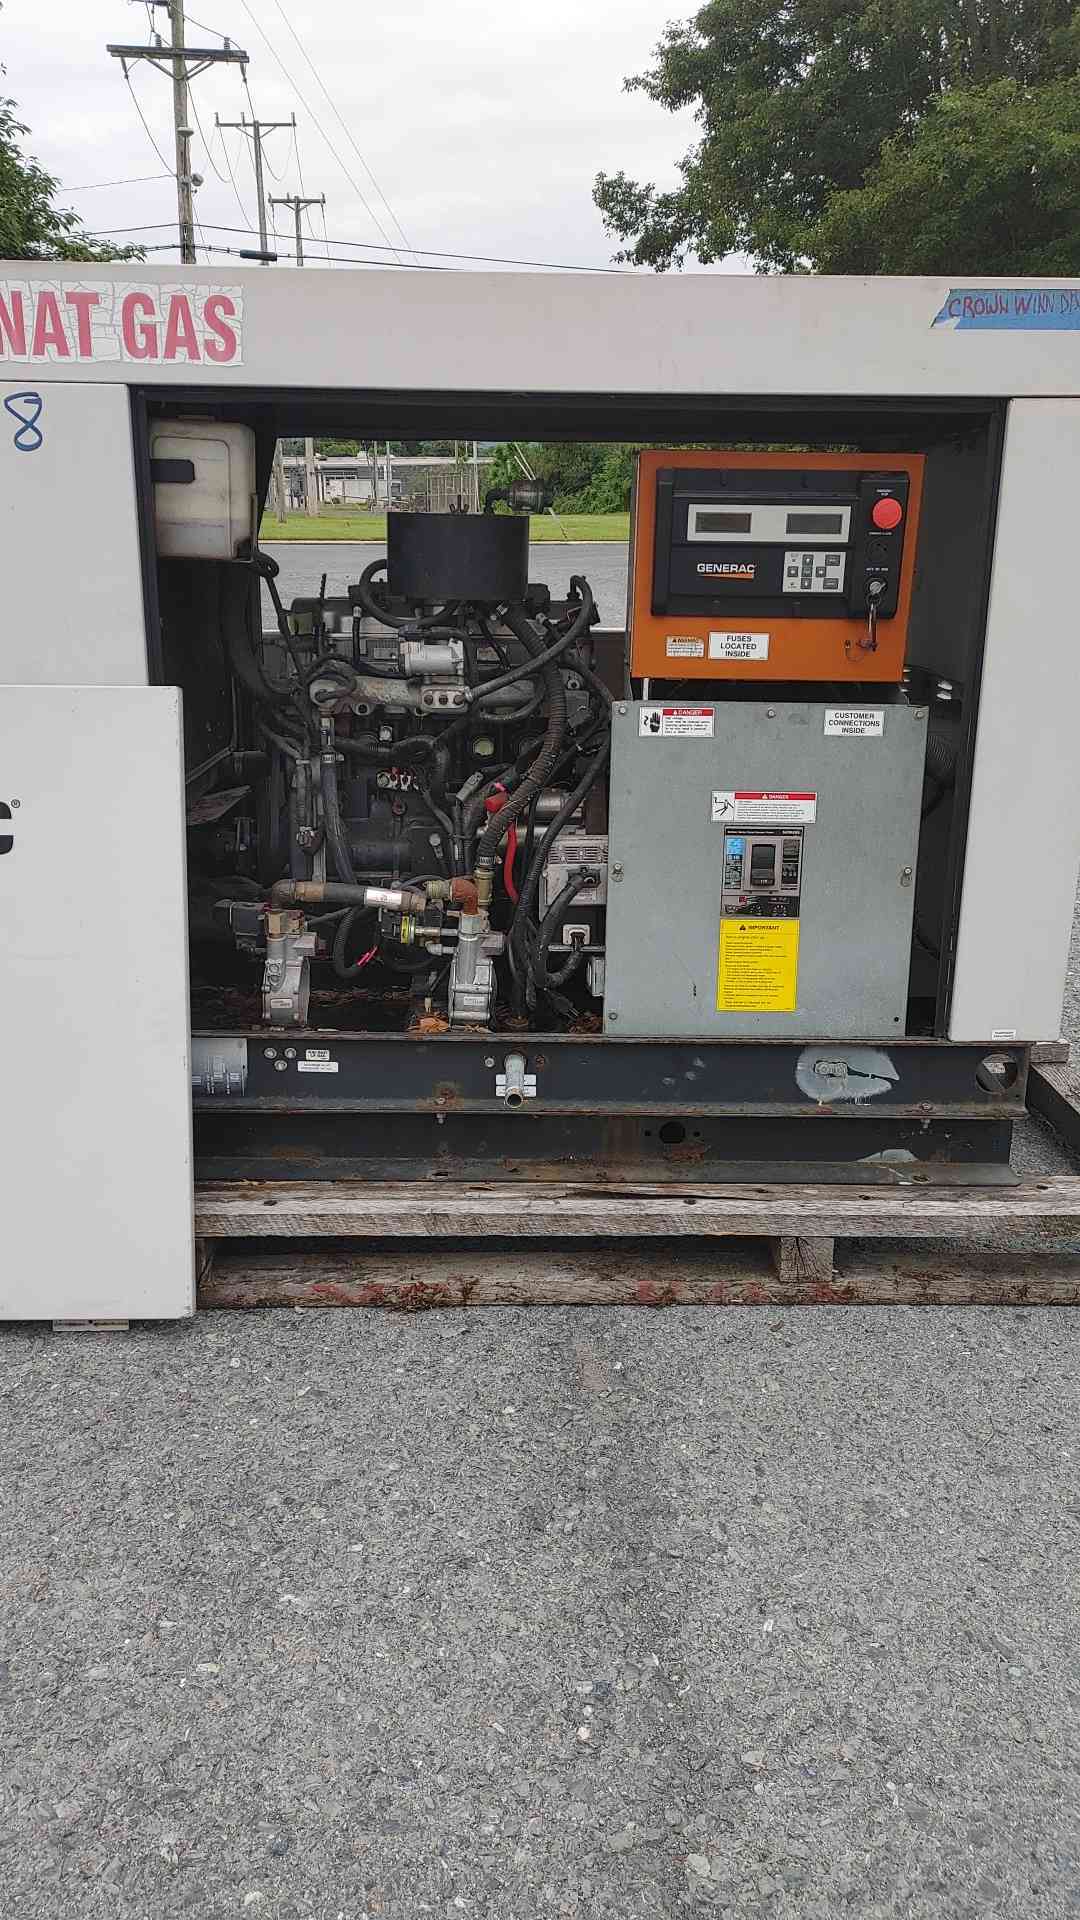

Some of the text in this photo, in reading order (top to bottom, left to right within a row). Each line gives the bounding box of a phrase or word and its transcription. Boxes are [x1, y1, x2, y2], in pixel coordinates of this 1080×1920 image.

[948, 294, 1008, 318] CROWN
[1015, 292, 1056, 315] WINN
[0, 290, 237, 362] NAT GAS
[4, 391, 43, 451] 8
[696, 563, 756, 574] GENERAC
[726, 634, 752, 643] FUSES
[720, 642, 757, 650] LOCATED
[725, 650, 751, 658] INSIDE
[834, 712, 875, 720] CUSTOMER
[828, 719, 881, 727] CONNECTIONS
